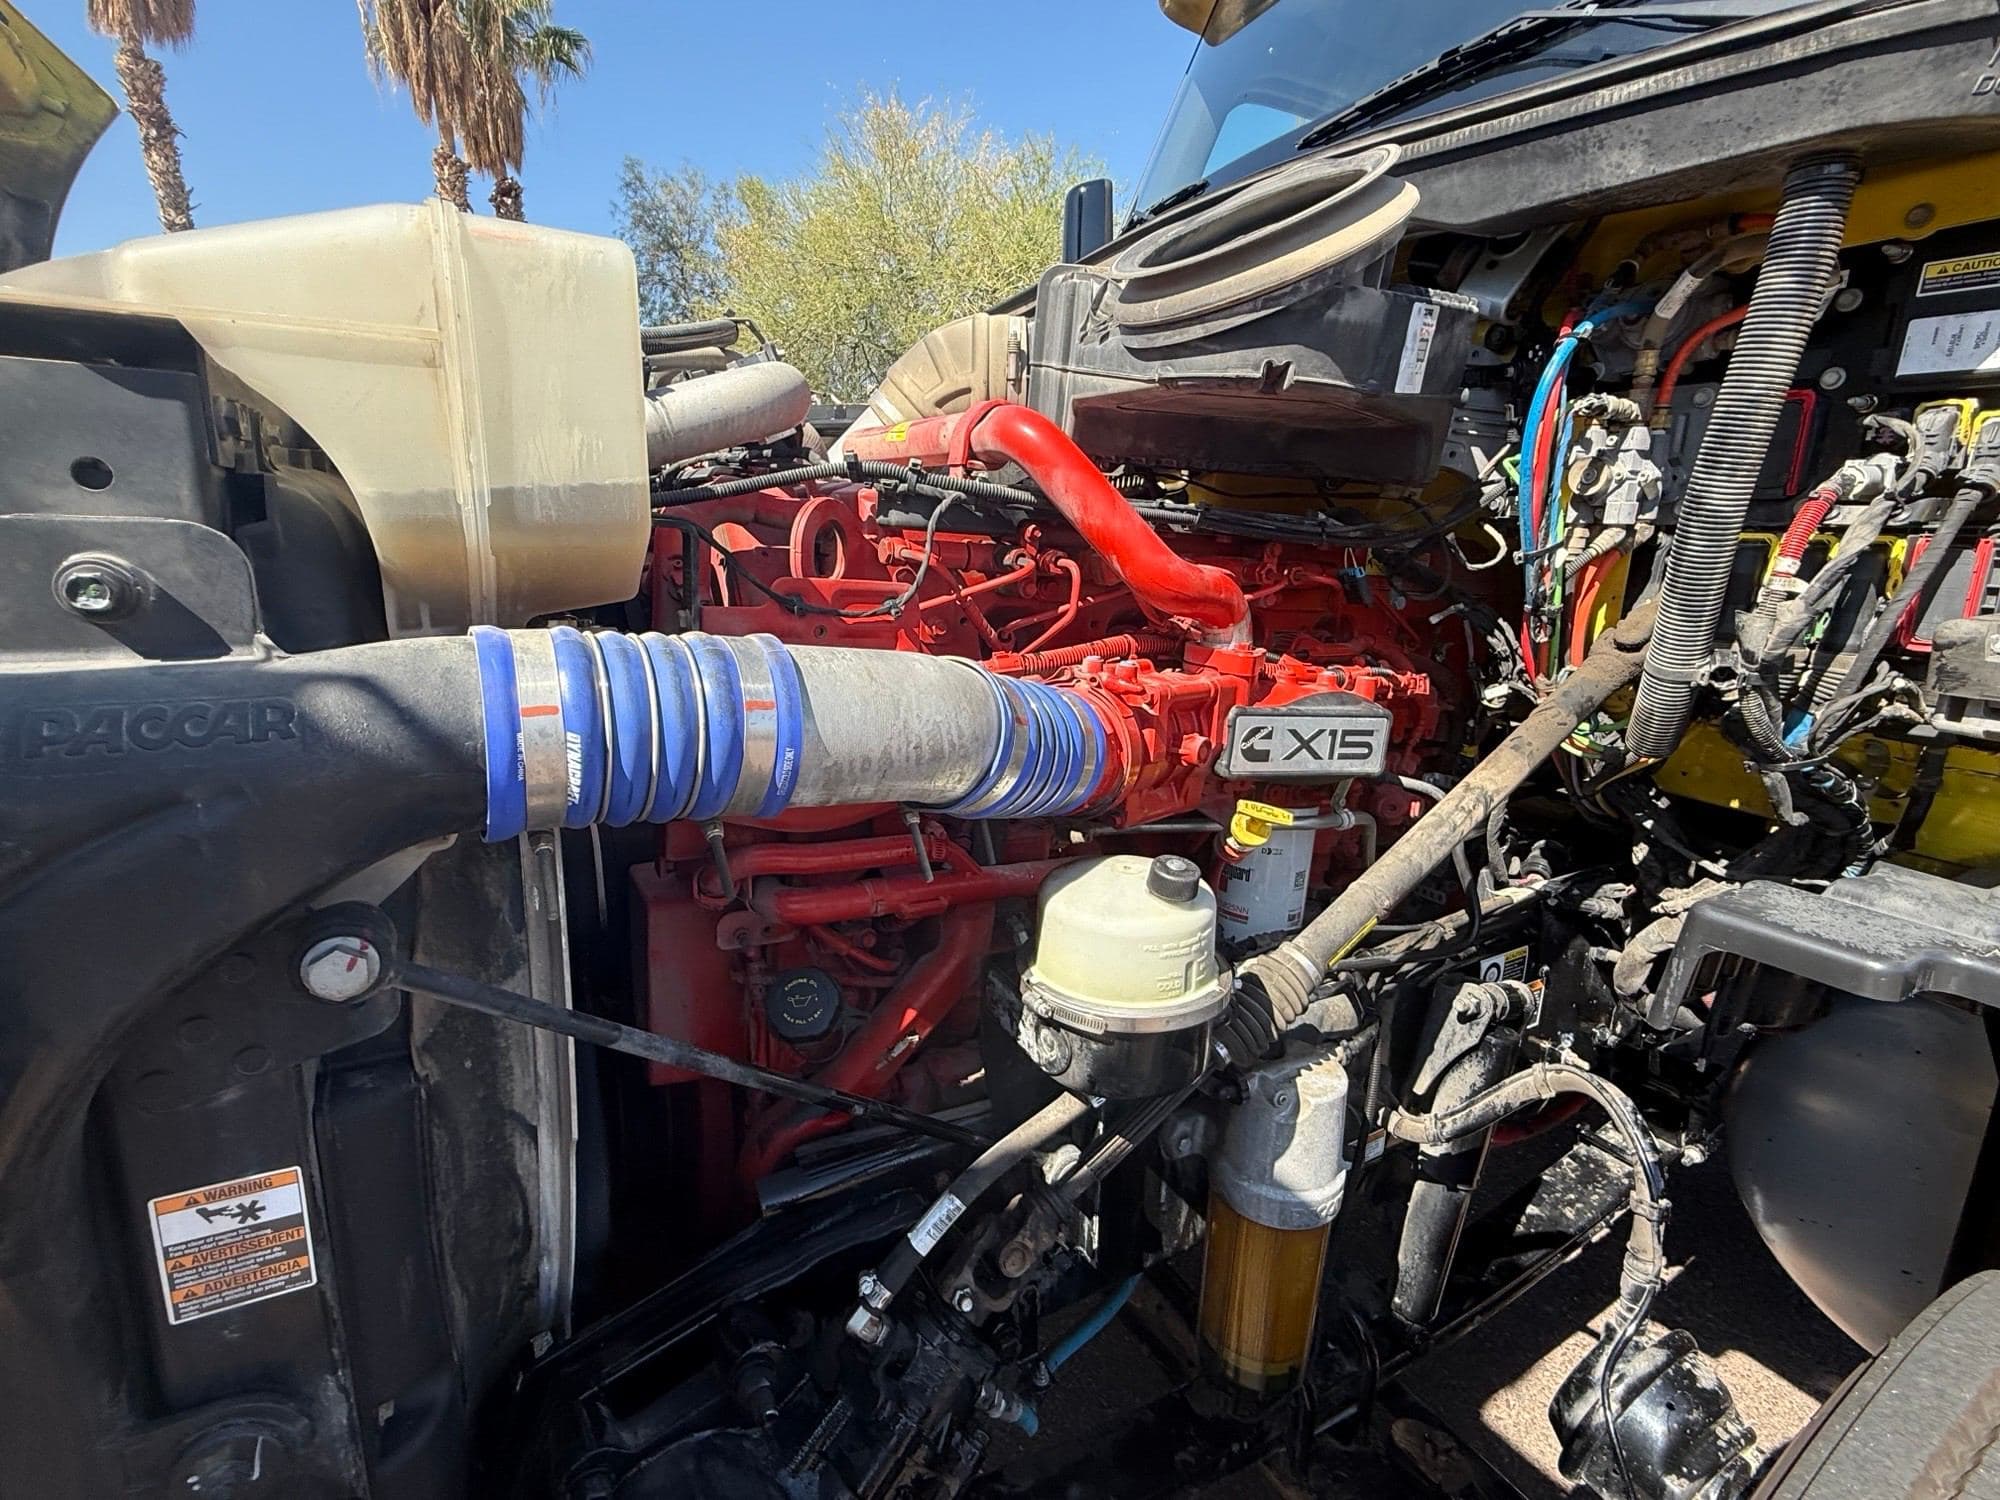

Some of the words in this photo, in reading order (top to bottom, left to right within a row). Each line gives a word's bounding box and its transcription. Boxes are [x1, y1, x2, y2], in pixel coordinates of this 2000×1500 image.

[22, 699, 298, 759] PACCAR
[1281, 728, 1375, 761] X15
[566, 731, 582, 805] DYNACRAFT
[203, 1177, 272, 1201] WARNING
[190, 1228, 301, 1265] AVERTISSEMENT
[203, 1258, 300, 1294] ADVERTENCIA
